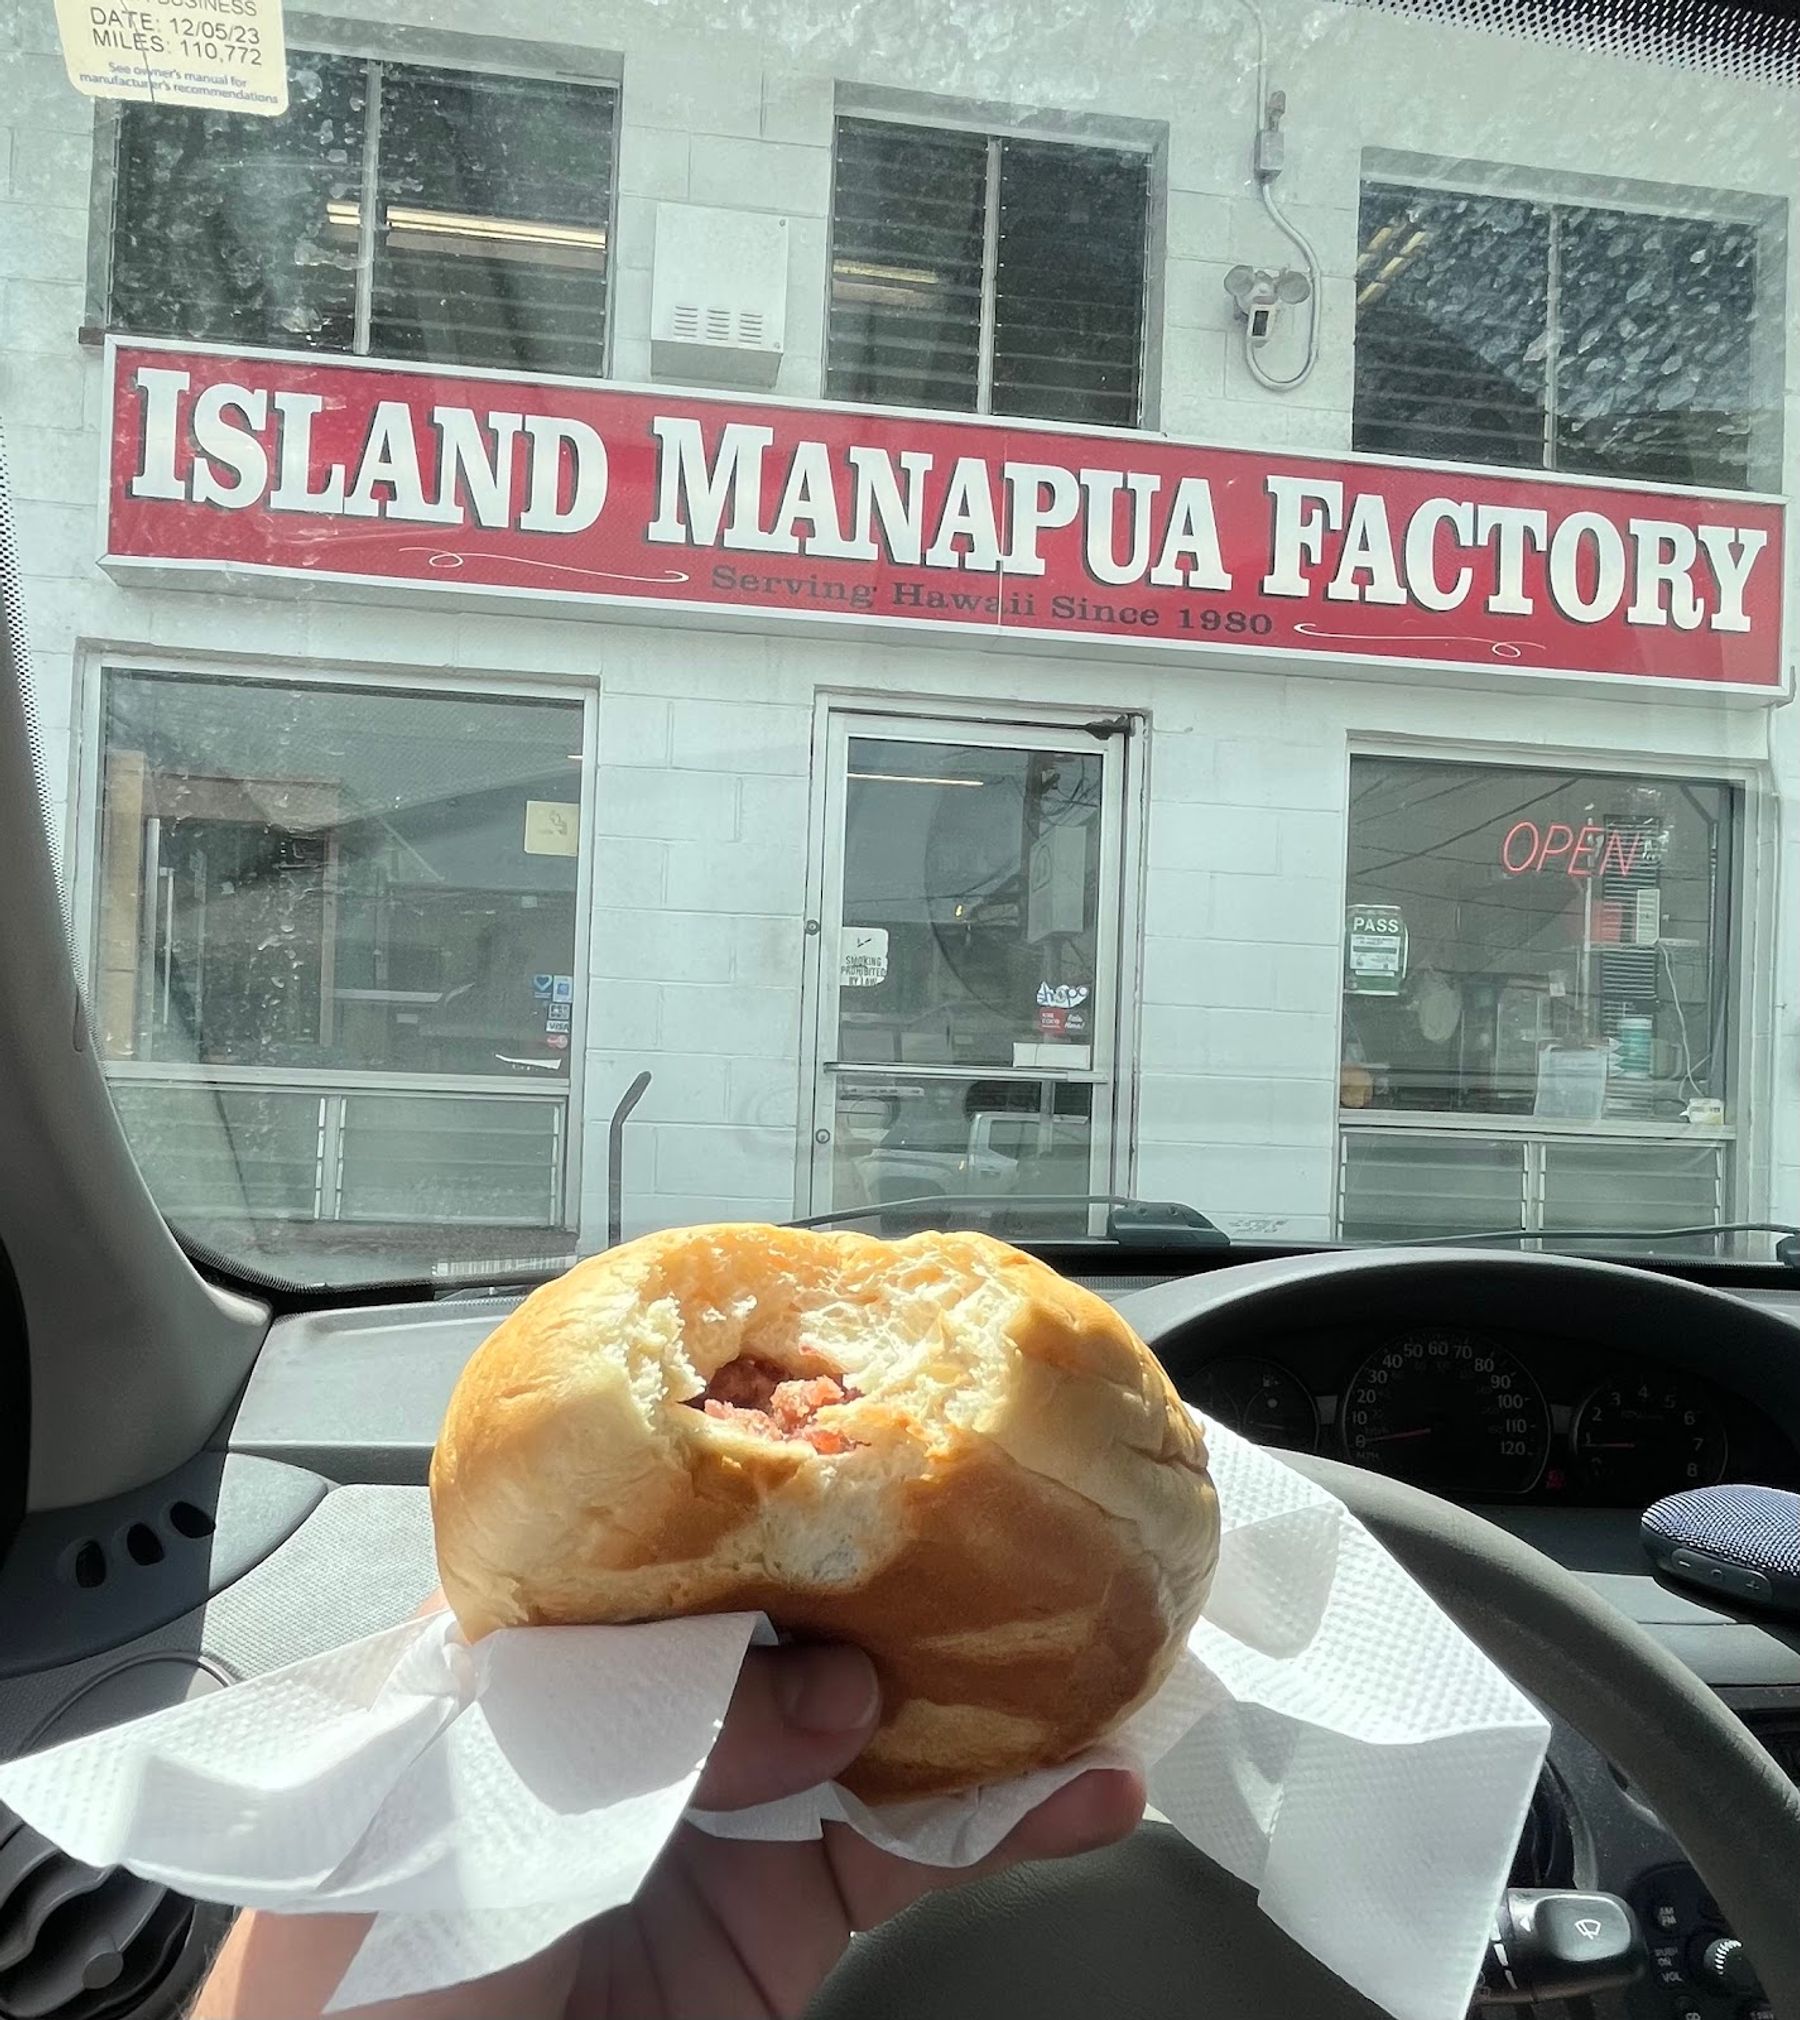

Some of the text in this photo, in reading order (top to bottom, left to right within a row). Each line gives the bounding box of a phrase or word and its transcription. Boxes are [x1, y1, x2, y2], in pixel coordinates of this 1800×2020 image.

[91, 7, 260, 45] DATE: 12/05/23
[92, 28, 262, 66] MILES: 110,772
[108, 61, 247, 87] See owner's manual for
[80, 74, 278, 104] manufacturer's recommendations
[129, 367, 1768, 634] ISLAND MANAPUA FACTORY
[711, 565, 1272, 635] Serving Hawaii Since 1980
[1503, 821, 1640, 876] OPEN
[1353, 916, 1399, 933] PASS
[845, 955, 882, 967] SMOKING
[548, 1022, 569, 1031] VISA
[1404, 1343, 1424, 1358] 50
[1428, 1342, 1448, 1356] 60
[1454, 1344, 1473, 1359] 70
[1382, 1354, 1403, 1368] 40
[1474, 1358, 1495, 1373] 80
[1368, 1370, 1388, 1384] 30
[1490, 1374, 1511, 1390] 90
[1356, 1389, 1376, 1404] 20
[1610, 1392, 1622, 1406] 3
[1638, 1385, 1649, 1400] 4
[1497, 1394, 1524, 1409] 100
[1351, 1410, 1368, 1425] 10
[1591, 1407, 1603, 1421] 2
[1683, 1410, 1697, 1425] 6
[1506, 1418, 1527, 1434] 110
[1500, 1440, 1526, 1456] 120
[1692, 1438, 1704, 1452] 7
[1686, 1463, 1699, 1477] 8
